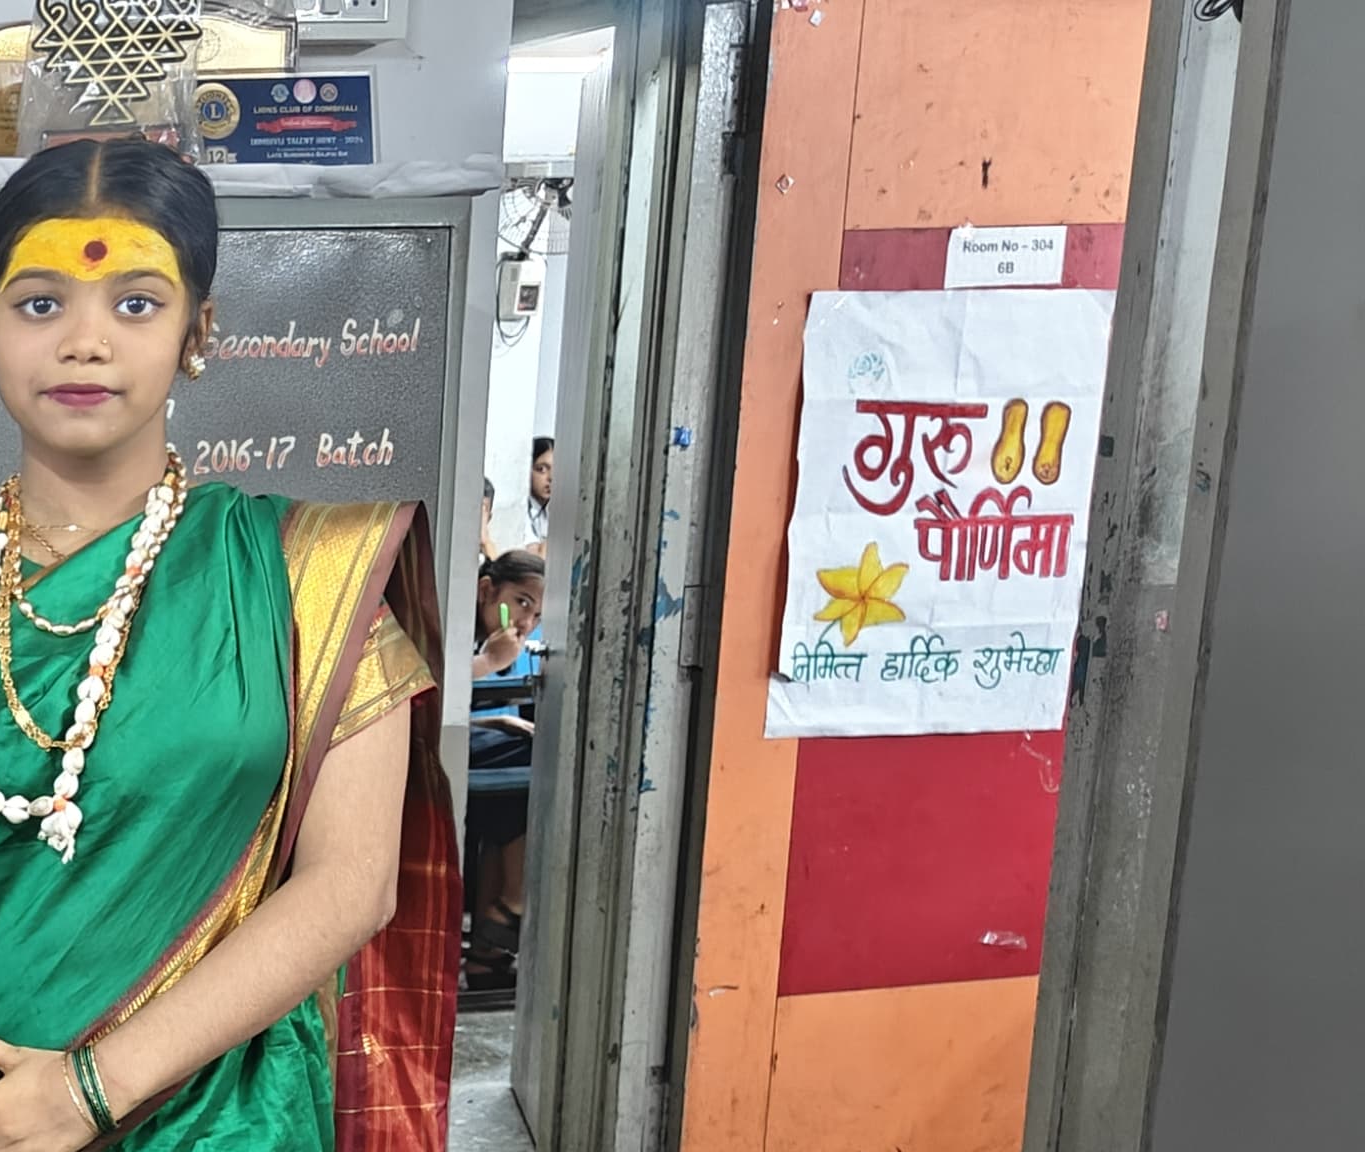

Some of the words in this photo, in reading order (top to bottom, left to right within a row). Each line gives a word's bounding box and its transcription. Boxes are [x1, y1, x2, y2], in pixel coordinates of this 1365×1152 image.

[279, 105, 301, 113] CLUB
[302, 104, 313, 113] OF
[962, 240, 999, 253] Room
[1001, 240, 1019, 252] No
[1031, 239, 1054, 251] 304
[997, 261, 1015, 274] 6B
[203, 320, 332, 368] Secondary
[339, 317, 421, 357] School
[193, 436, 297, 475] 2016-17
[315, 427, 395, 468] Batch
[880, 634, 962, 684] हार्दिक
